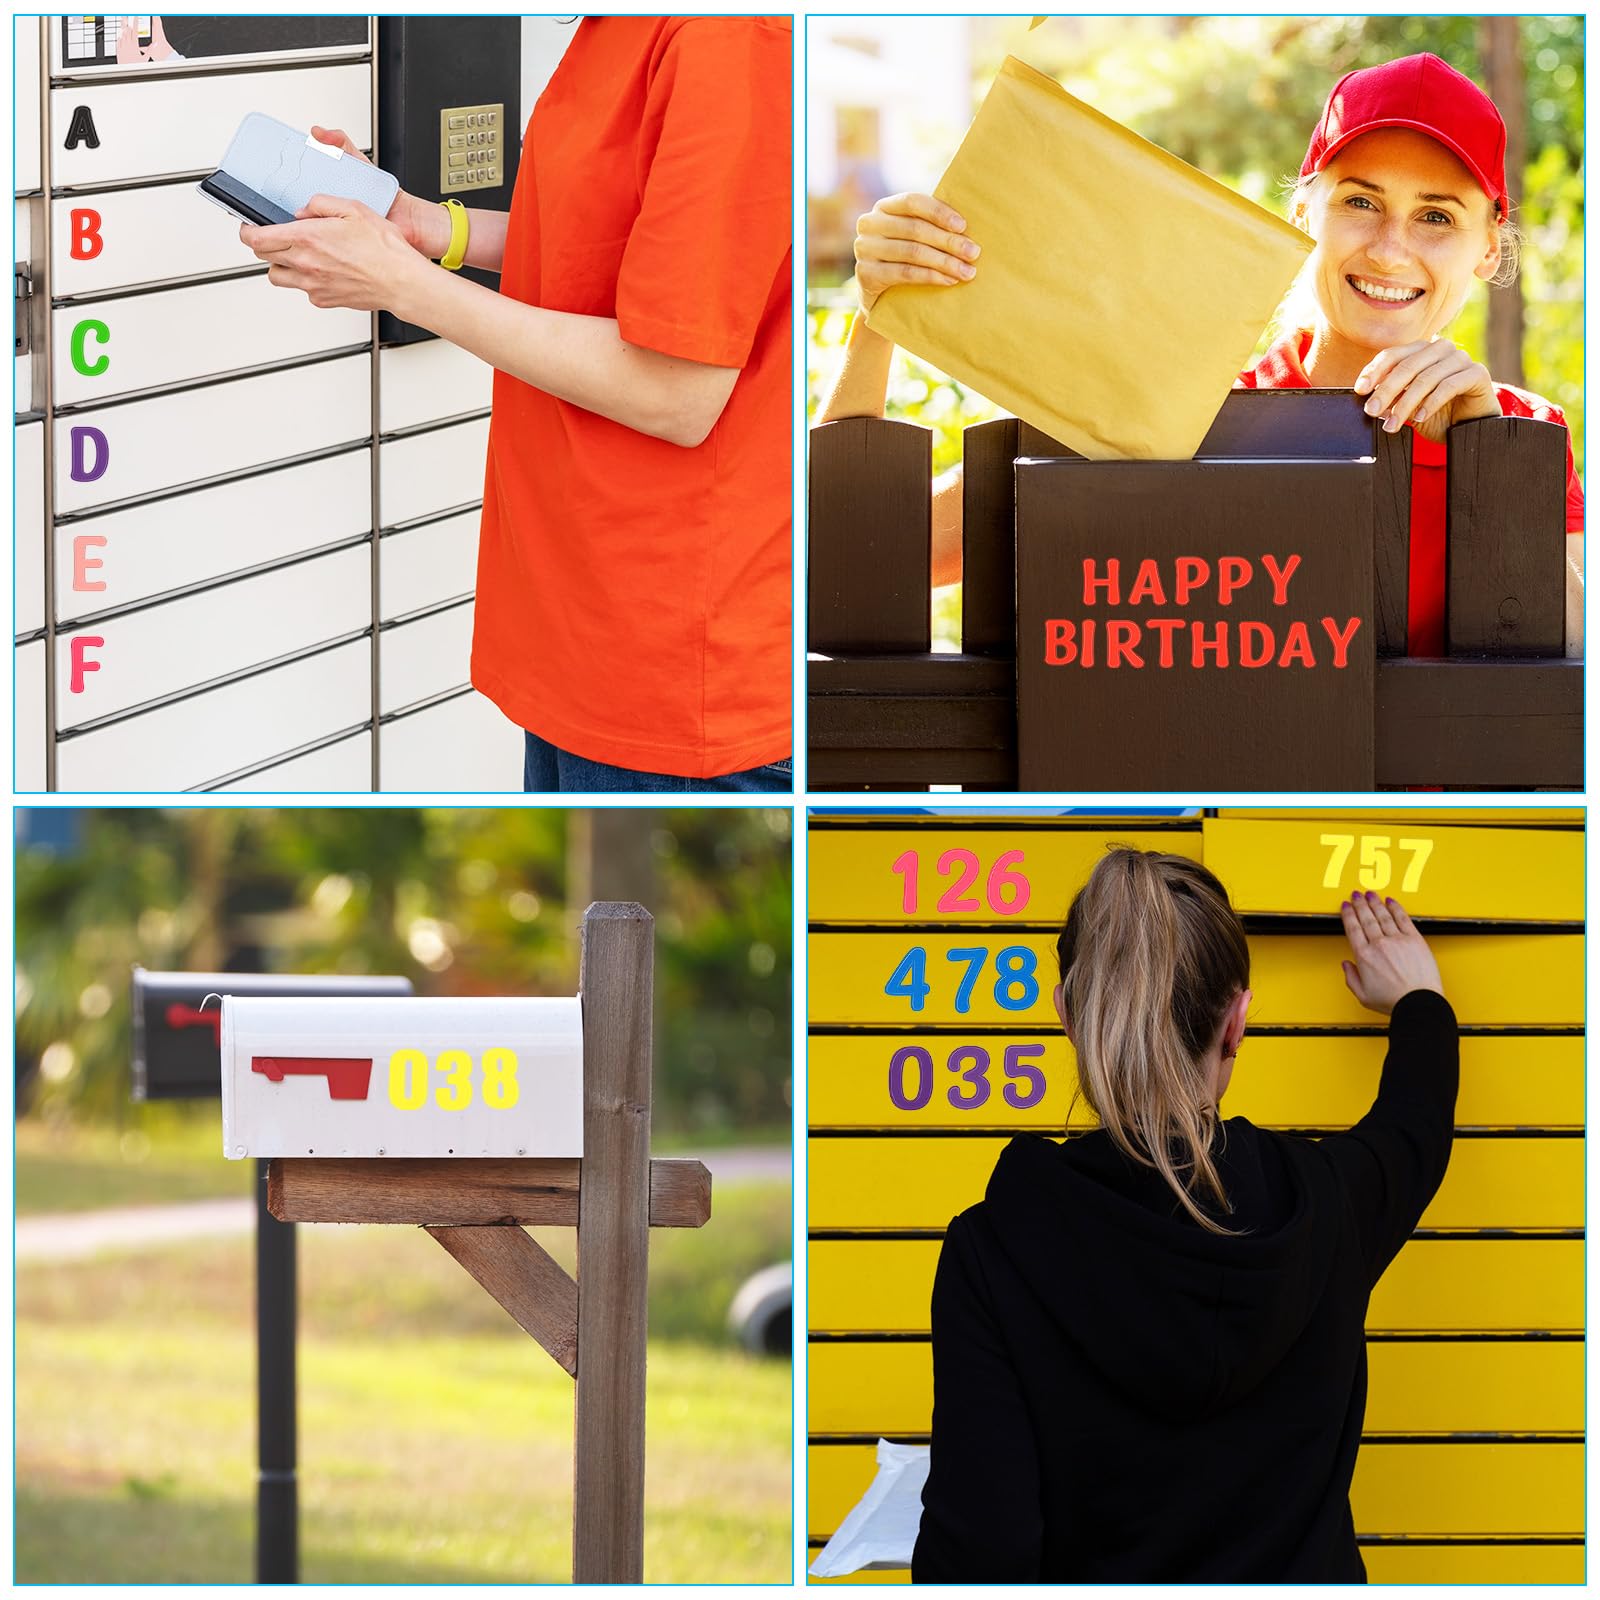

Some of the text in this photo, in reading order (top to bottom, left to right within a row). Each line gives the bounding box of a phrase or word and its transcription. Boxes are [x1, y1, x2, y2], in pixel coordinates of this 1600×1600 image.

[64, 105, 100, 150] A
[70, 208, 104, 260] B
[70, 319, 110, 376] C
[70, 426, 109, 482] D
[72, 535, 108, 592] E
[1083, 554, 1301, 605] HAPPY
[70, 636, 104, 693] F
[1044, 617, 1361, 668] BIRTHDAY
[891, 848, 1031, 915] 126
[1319, 833, 1434, 892] 757
[884, 946, 1039, 1013] 478
[389, 1047, 520, 1111] 038
[888, 1044, 1047, 1110] 035
